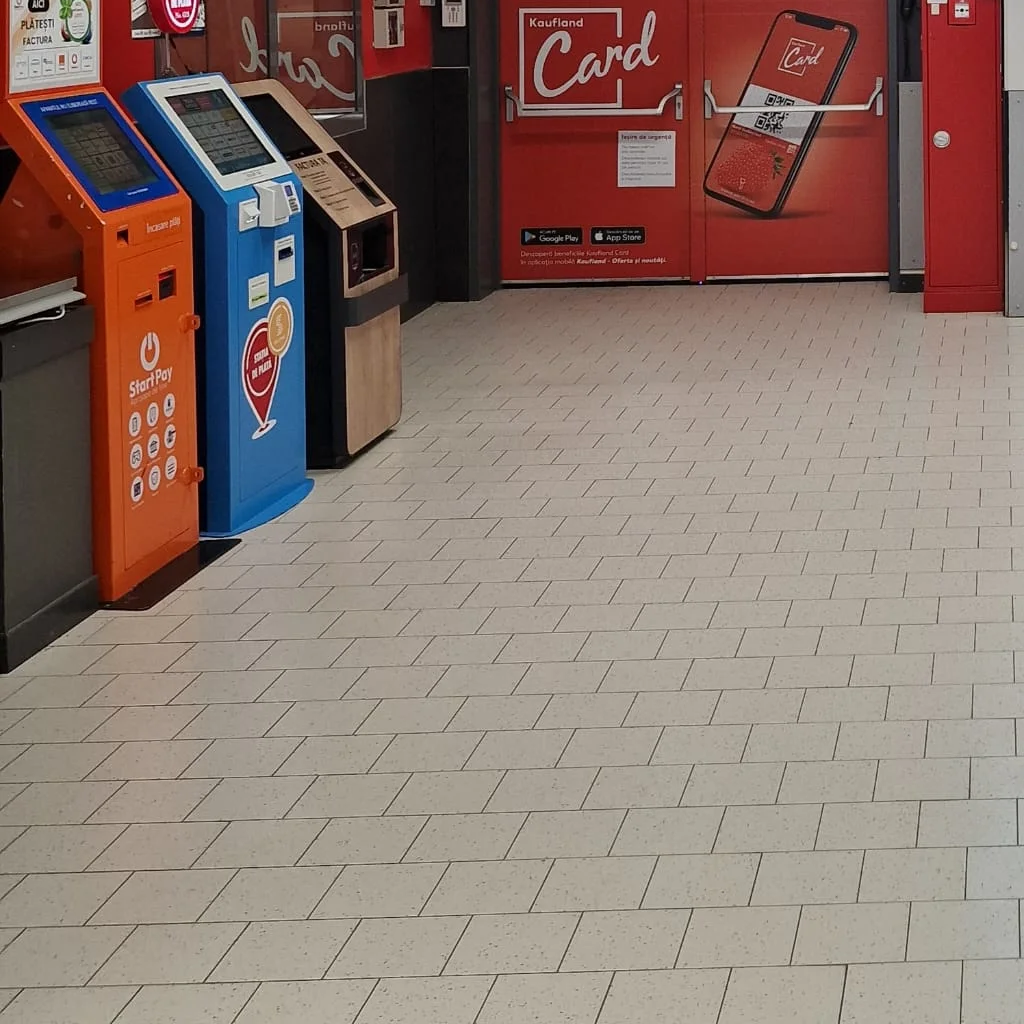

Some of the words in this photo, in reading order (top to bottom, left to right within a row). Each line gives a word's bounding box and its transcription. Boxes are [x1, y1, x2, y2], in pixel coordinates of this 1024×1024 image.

[528, 17, 584, 29] Kaufland
[533, 10, 660, 98] Card
[784, 46, 825, 68] Card
[540, 234, 564, 244] Google
[565, 234, 579, 243] Play
[606, 234, 621, 242] App
